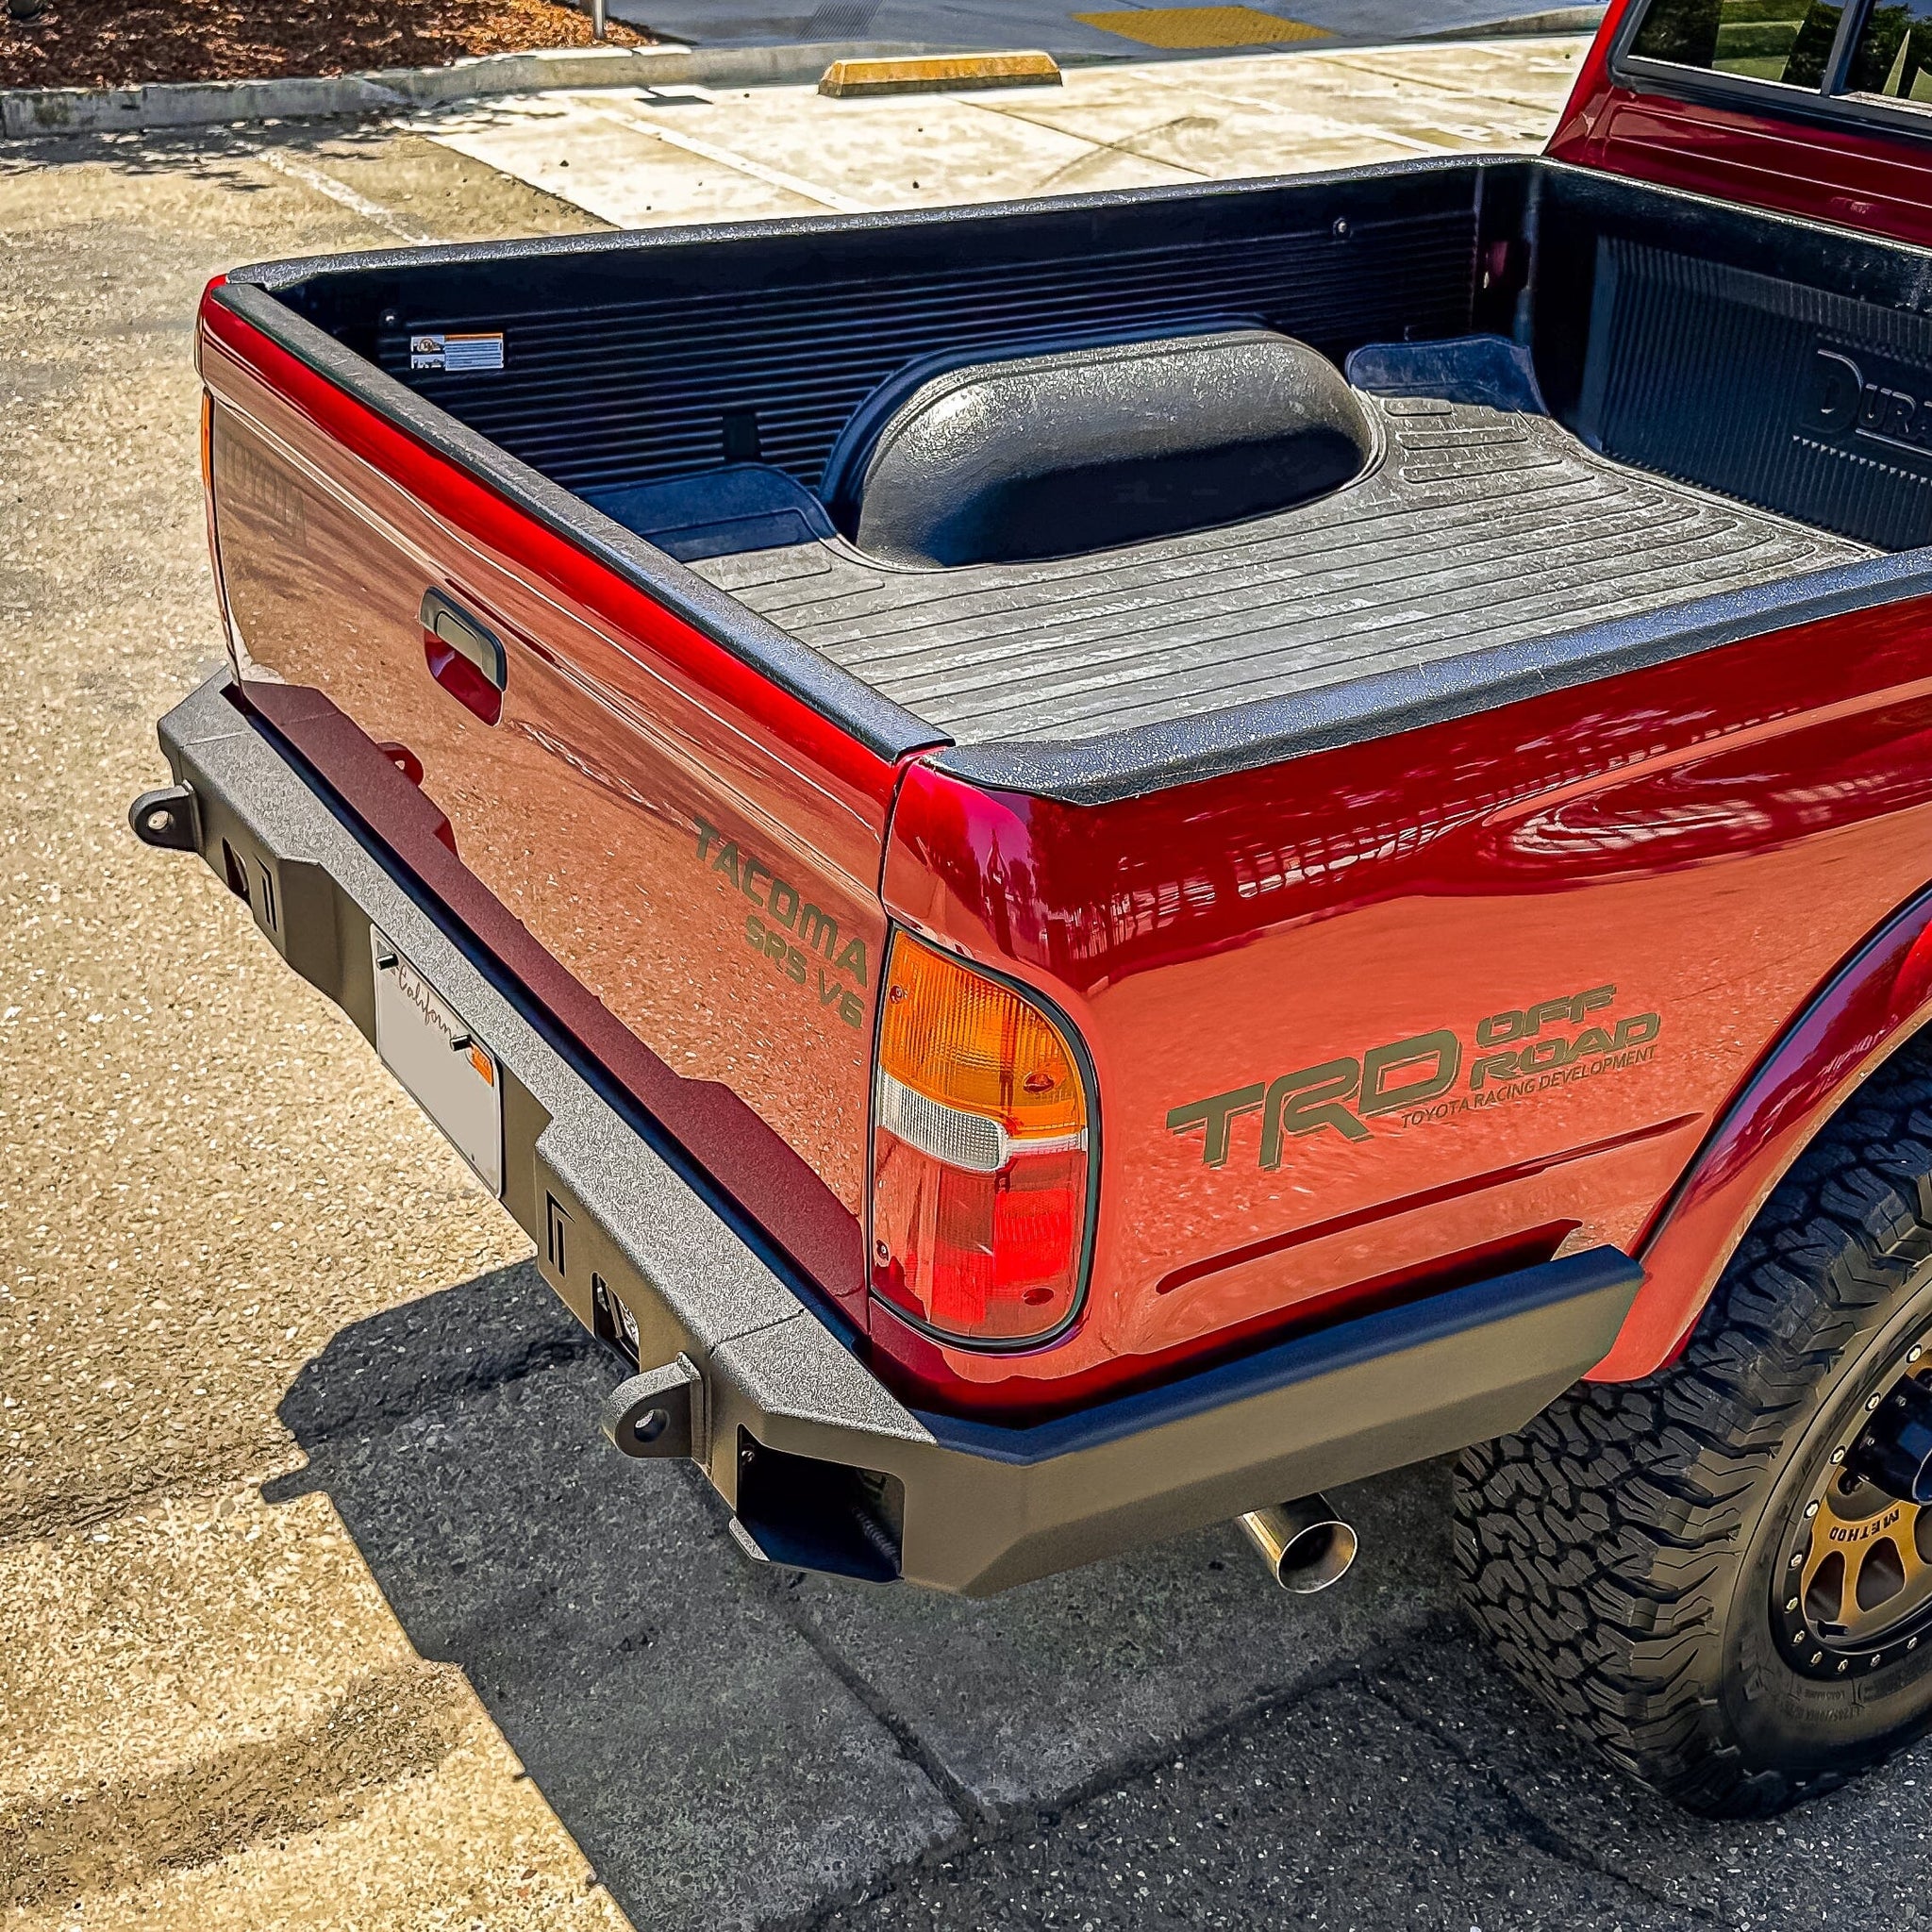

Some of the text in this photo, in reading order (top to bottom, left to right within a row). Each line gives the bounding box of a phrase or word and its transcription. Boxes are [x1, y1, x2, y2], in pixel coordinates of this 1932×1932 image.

[693, 816, 868, 989] TACOMA
[396, 964, 458, 1040] Californ
[819, 968, 865, 1029] V6
[1475, 984, 1617, 1049] OFF
[1401, 1044, 1657, 1128] TOYOTA RACING DEVELOPMENT
[1469, 1012, 1661, 1092] ROAD
[1166, 1029, 1462, 1171] TRD
[1828, 1508, 1900, 1542] METHOD
